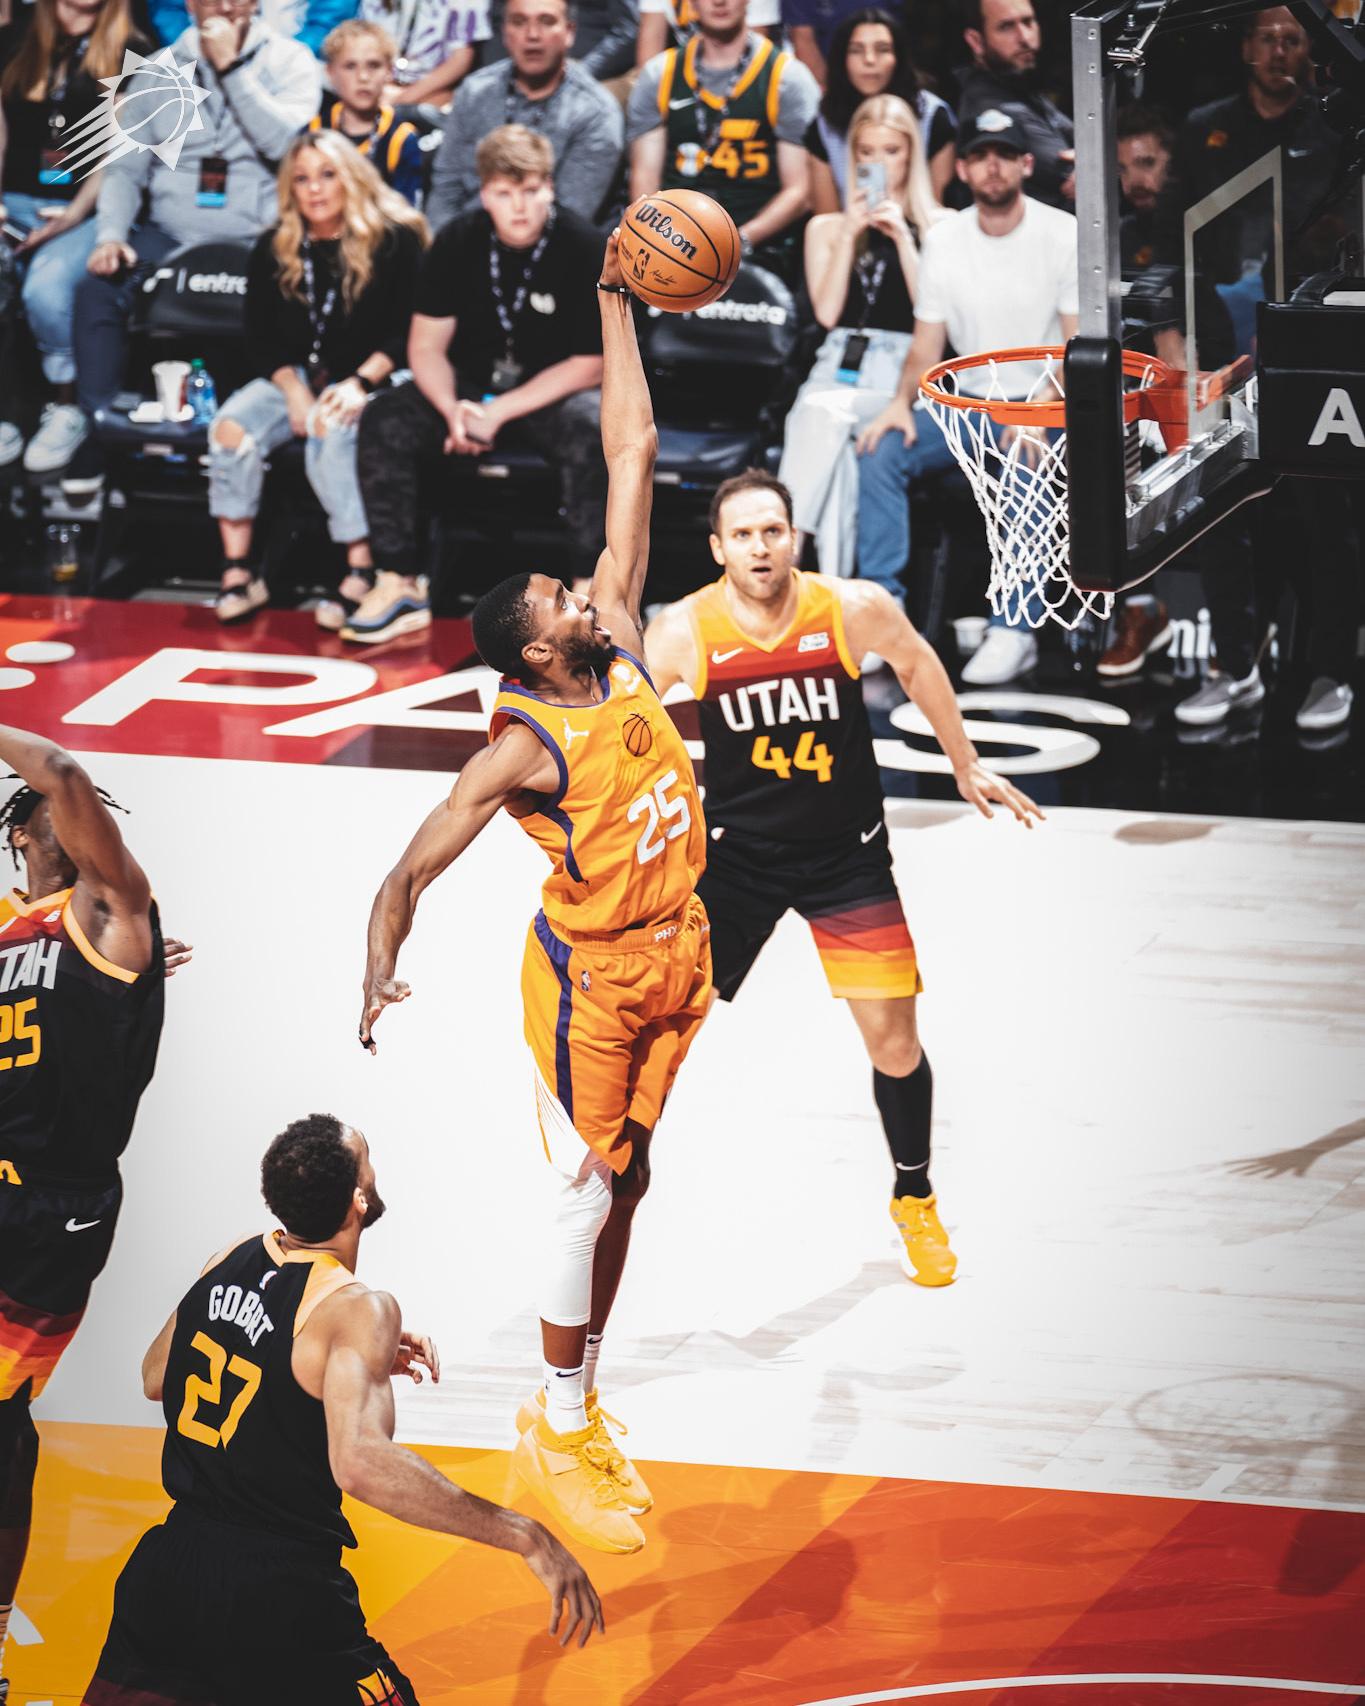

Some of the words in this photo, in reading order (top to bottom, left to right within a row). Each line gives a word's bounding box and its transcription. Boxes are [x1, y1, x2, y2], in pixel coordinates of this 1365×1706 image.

[711, 139, 769, 179] 45
[635, 203, 698, 260] Wilson
[718, 676, 840, 732] UTAH
[751, 730, 834, 783] 44
[626, 769, 691, 865] 25
[177, 1330, 263, 1450] 27
